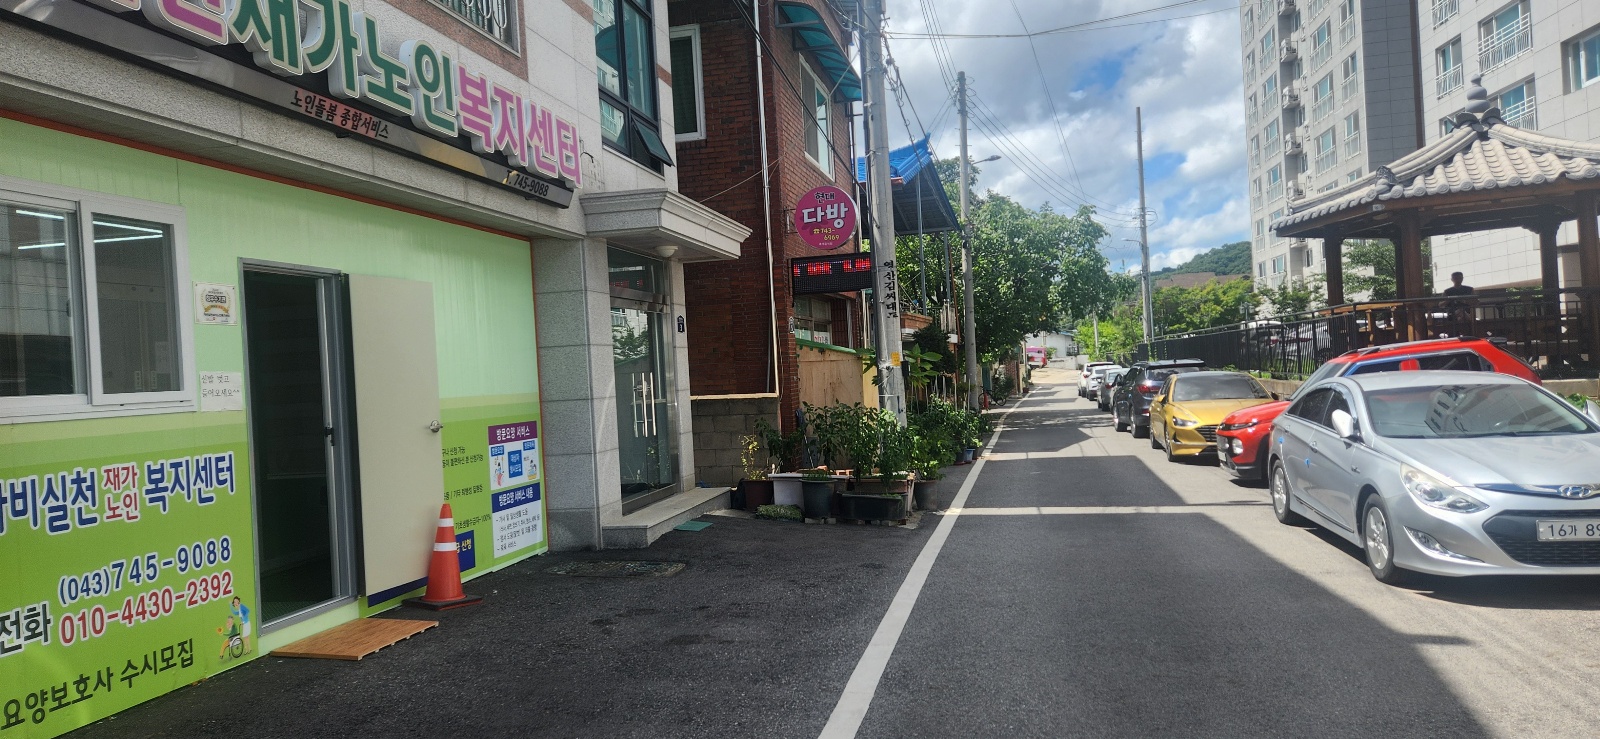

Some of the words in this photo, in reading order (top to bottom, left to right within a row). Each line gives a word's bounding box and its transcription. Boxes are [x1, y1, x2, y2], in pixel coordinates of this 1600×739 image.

[291, 93, 336, 123] 노인돌봄
[340, 107, 390, 140] 종합서비스
[815, 192, 835, 204] 현대
[802, 203, 848, 228] 다방
[202, 374, 215, 384] 신발
[217, 374, 230, 384] 벗고
[496, 427, 516, 441] 방문요양
[516, 425, 530, 438] 서비스
[103, 464, 138, 491] 재가
[145, 453, 235, 512] 복지센터
[105, 492, 139, 521] 노인
[498, 491, 515, 507] 방문요양
[514, 489, 526, 502] 서비스
[525, 486, 534, 499] 내용
[1548, 524, 1577, 537] 16가
[59, 537, 231, 604] (043)745-9088
[0, 604, 51, 655] 전화
[59, 571, 233, 644] 010-4430-2392
[1, 667, 114, 731] 요양보호사
[119, 638, 194, 688] 수시모집
